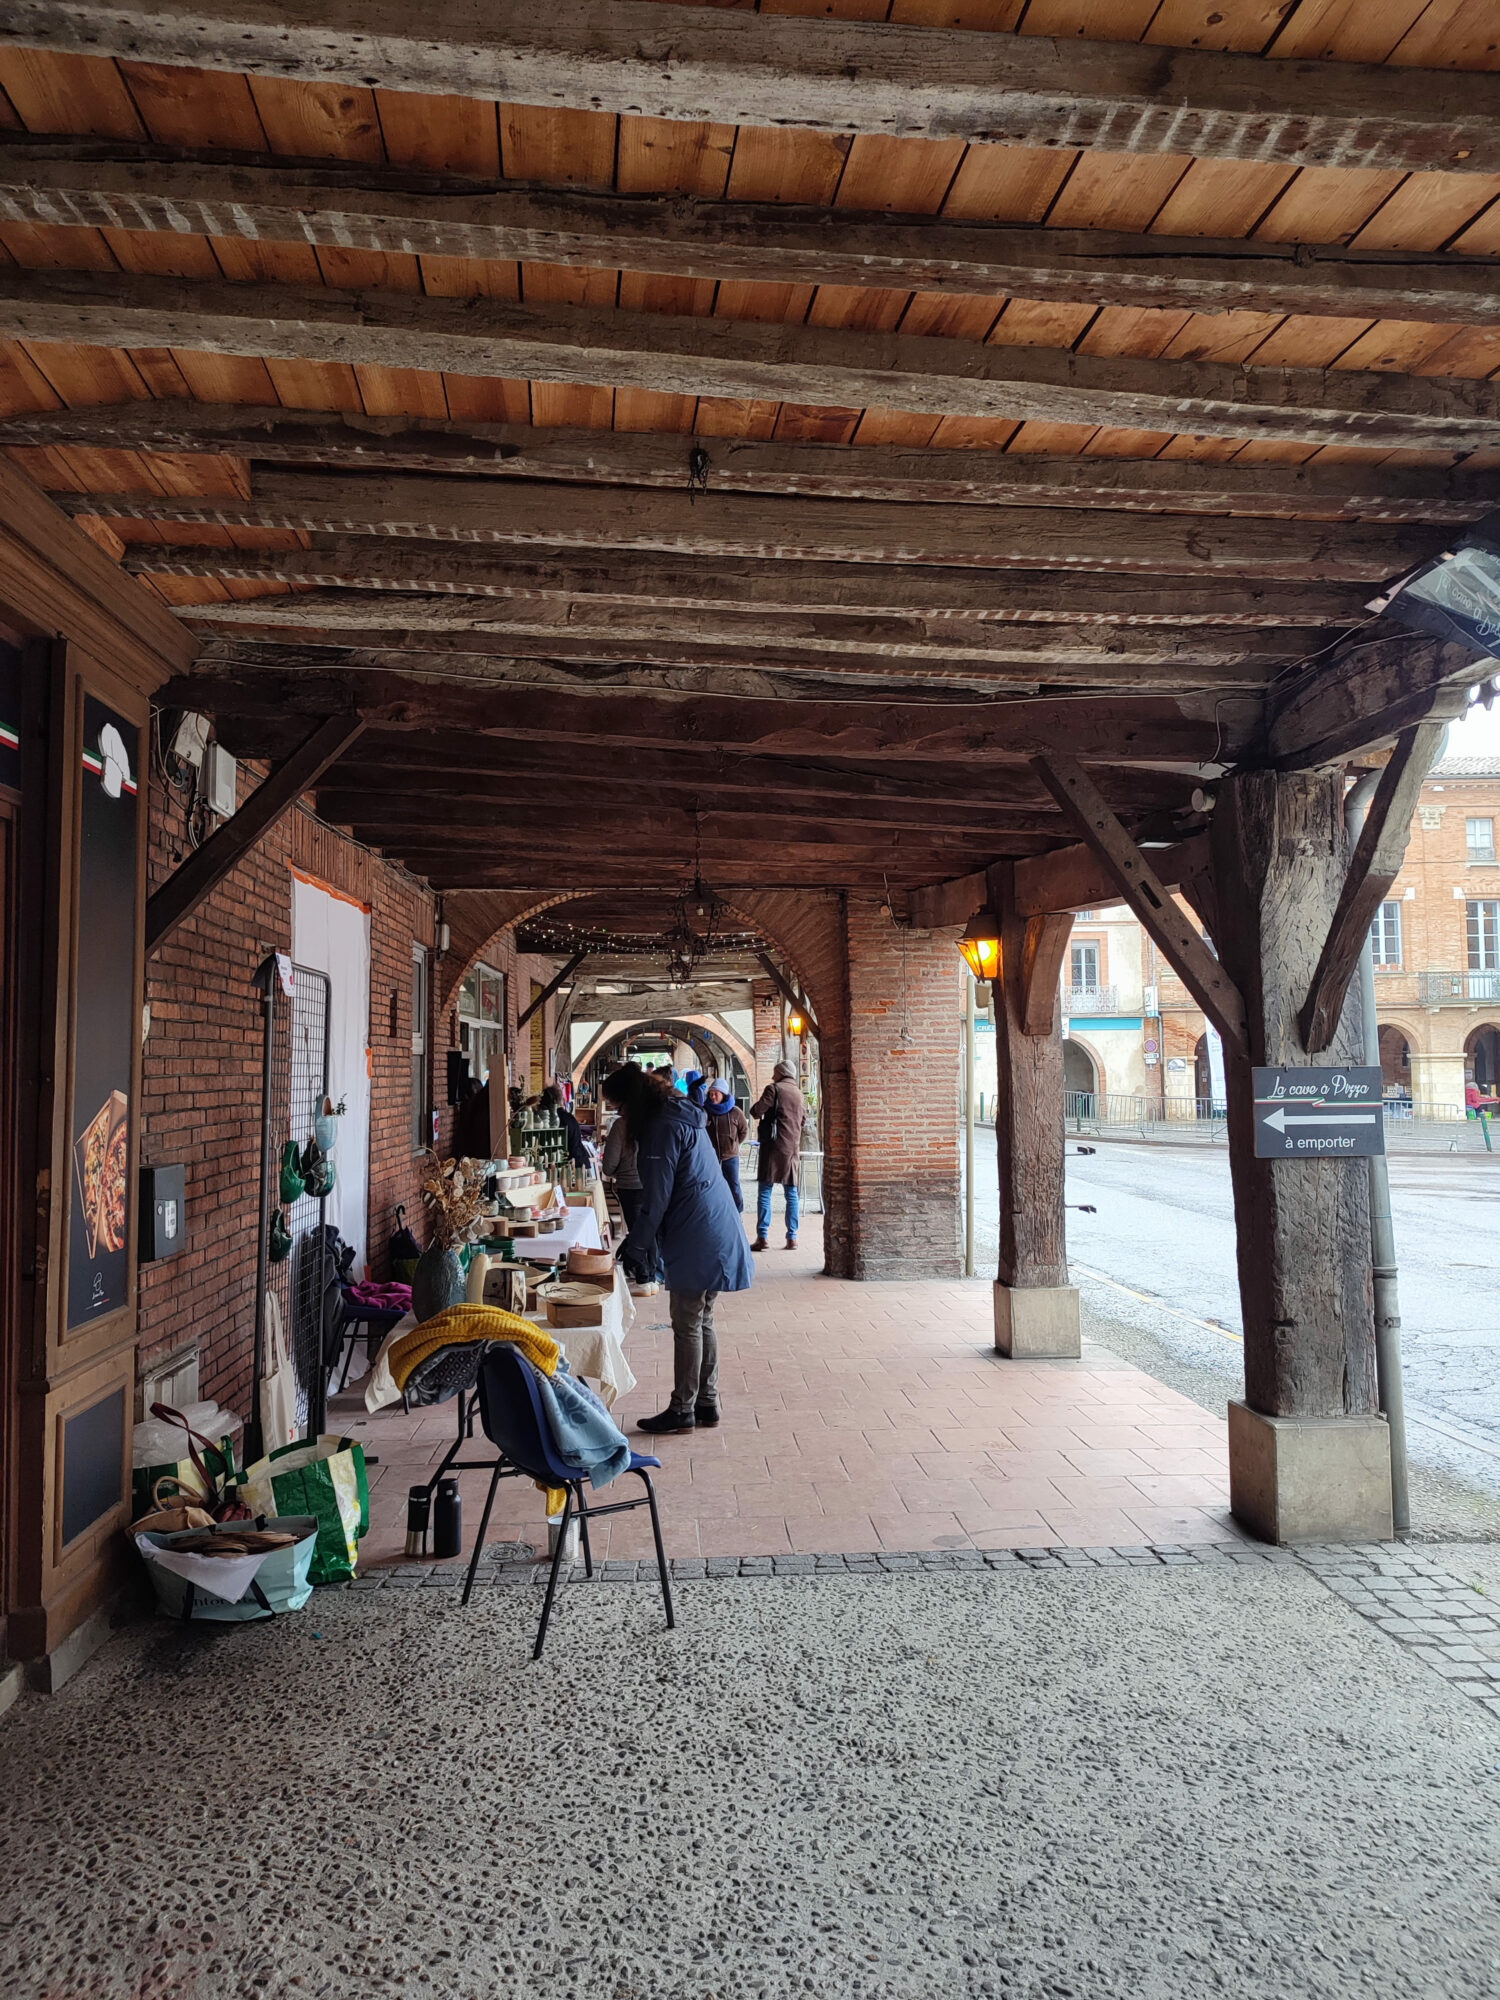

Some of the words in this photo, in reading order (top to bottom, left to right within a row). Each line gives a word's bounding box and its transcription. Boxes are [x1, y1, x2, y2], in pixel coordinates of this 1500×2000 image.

[1267, 1075, 1286, 1099] La
[1289, 1084, 1318, 1096] cave
[1320, 1083, 1330, 1095] à
[1331, 1074, 1370, 1099] Pizza
[1285, 1136, 1294, 1149] à
[1297, 1136, 1356, 1151] emporter
